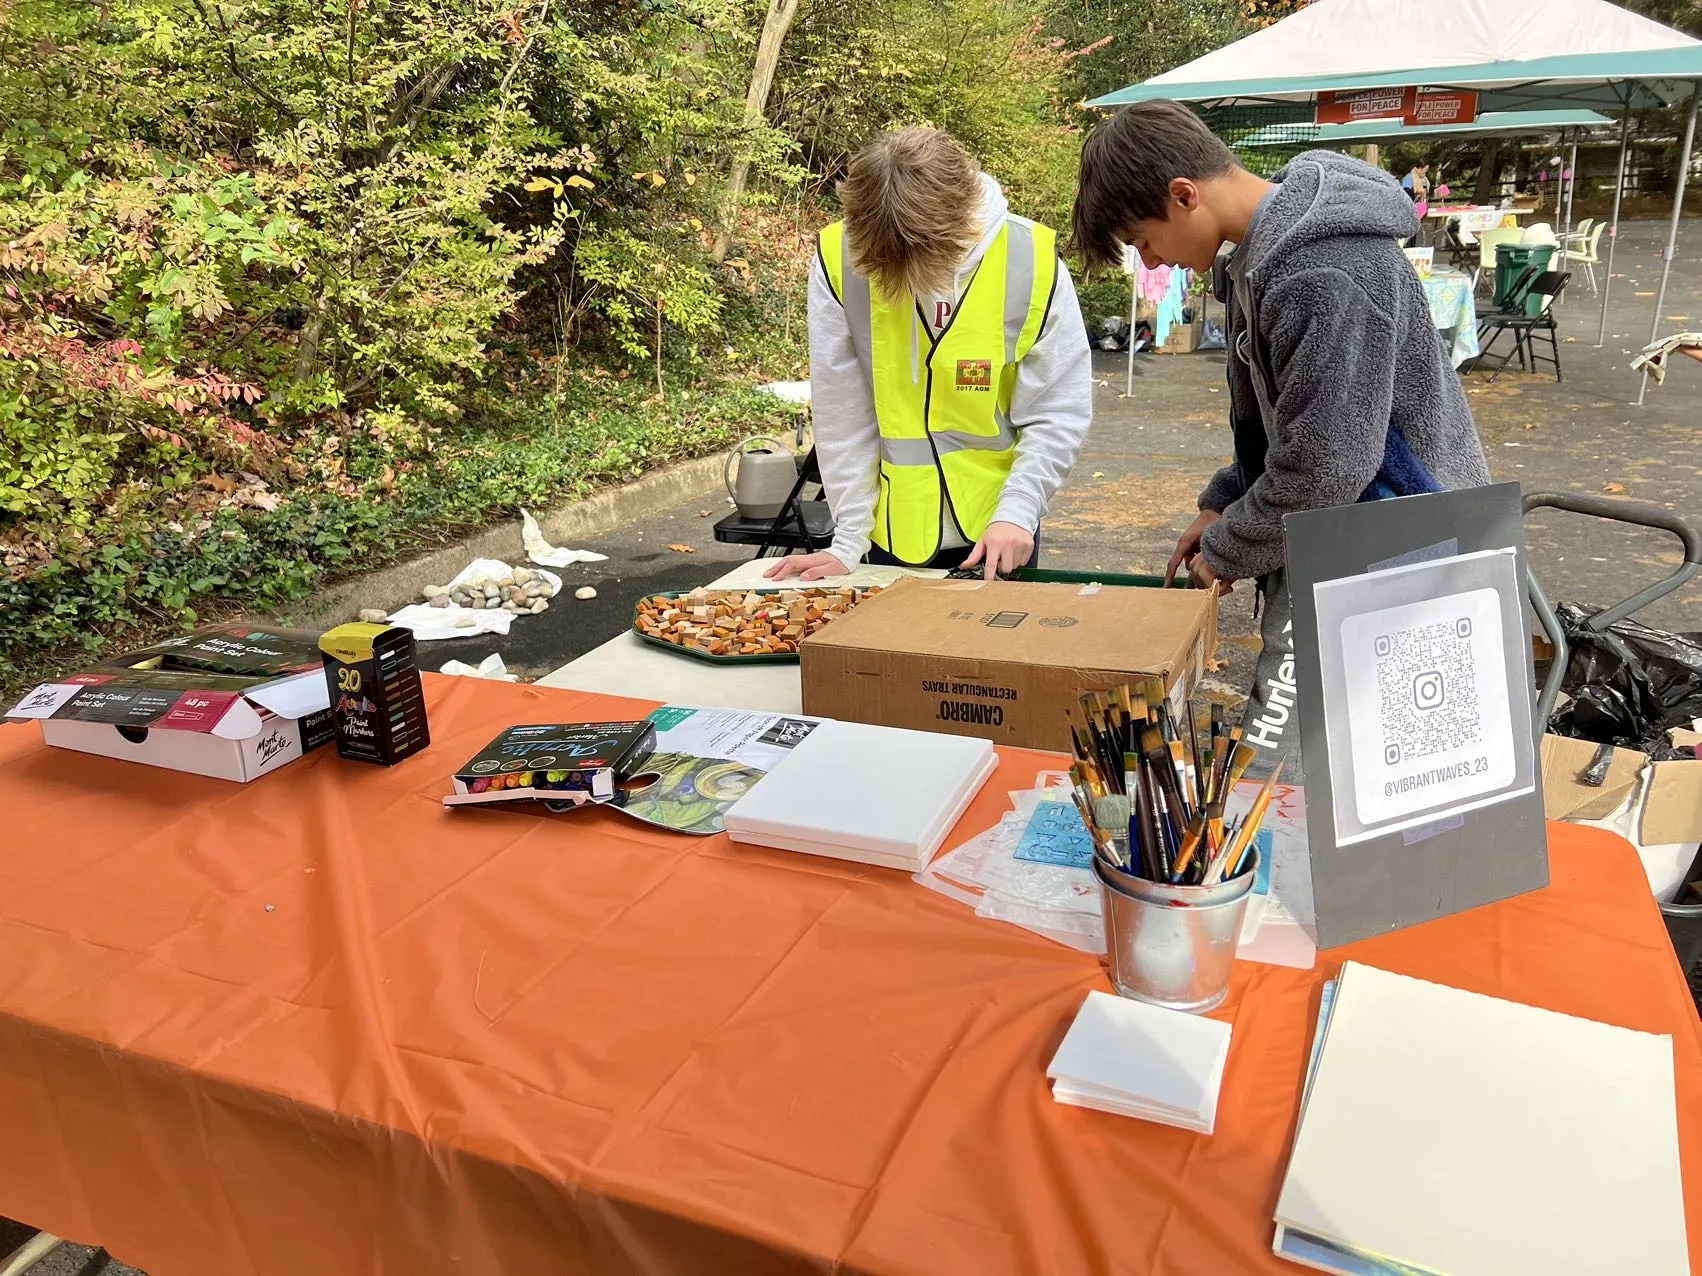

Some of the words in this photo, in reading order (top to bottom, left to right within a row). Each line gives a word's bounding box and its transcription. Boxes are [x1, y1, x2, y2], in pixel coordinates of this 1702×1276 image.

[1372, 88, 1404, 98] POWER
[1351, 103, 1368, 112] FOR
[1372, 100, 1400, 110] PEACE
[1435, 100, 1460, 109] POWER
[1418, 111, 1431, 119] FOR
[1434, 110, 1456, 118] PEACE
[193, 643, 225, 654] Paint
[224, 649, 245, 657] Set
[206, 638, 245, 650] Acrylic
[245, 647, 283, 656] Colour
[338, 667, 361, 692] 20
[922, 680, 950, 694] TRAYS
[952, 681, 1017, 700] RECTANGULAR
[80, 692, 105, 702] Acrylic
[105, 692, 132, 702] Colour
[185, 698, 199, 706] 48
[194, 700, 209, 708] pc
[71, 700, 91, 708] Paint
[91, 700, 106, 708] Set
[939, 701, 1004, 726] CAMBRO
[306, 714, 325, 727] Paint
[346, 716, 368, 727] Paint
[343, 724, 375, 737] Markers
[257, 729, 278, 754] Mont
[262, 736, 286, 760] Marte
[502, 739, 618, 757] Acrylic
[1385, 757, 1489, 796] @VIBRANTWAVES_23
